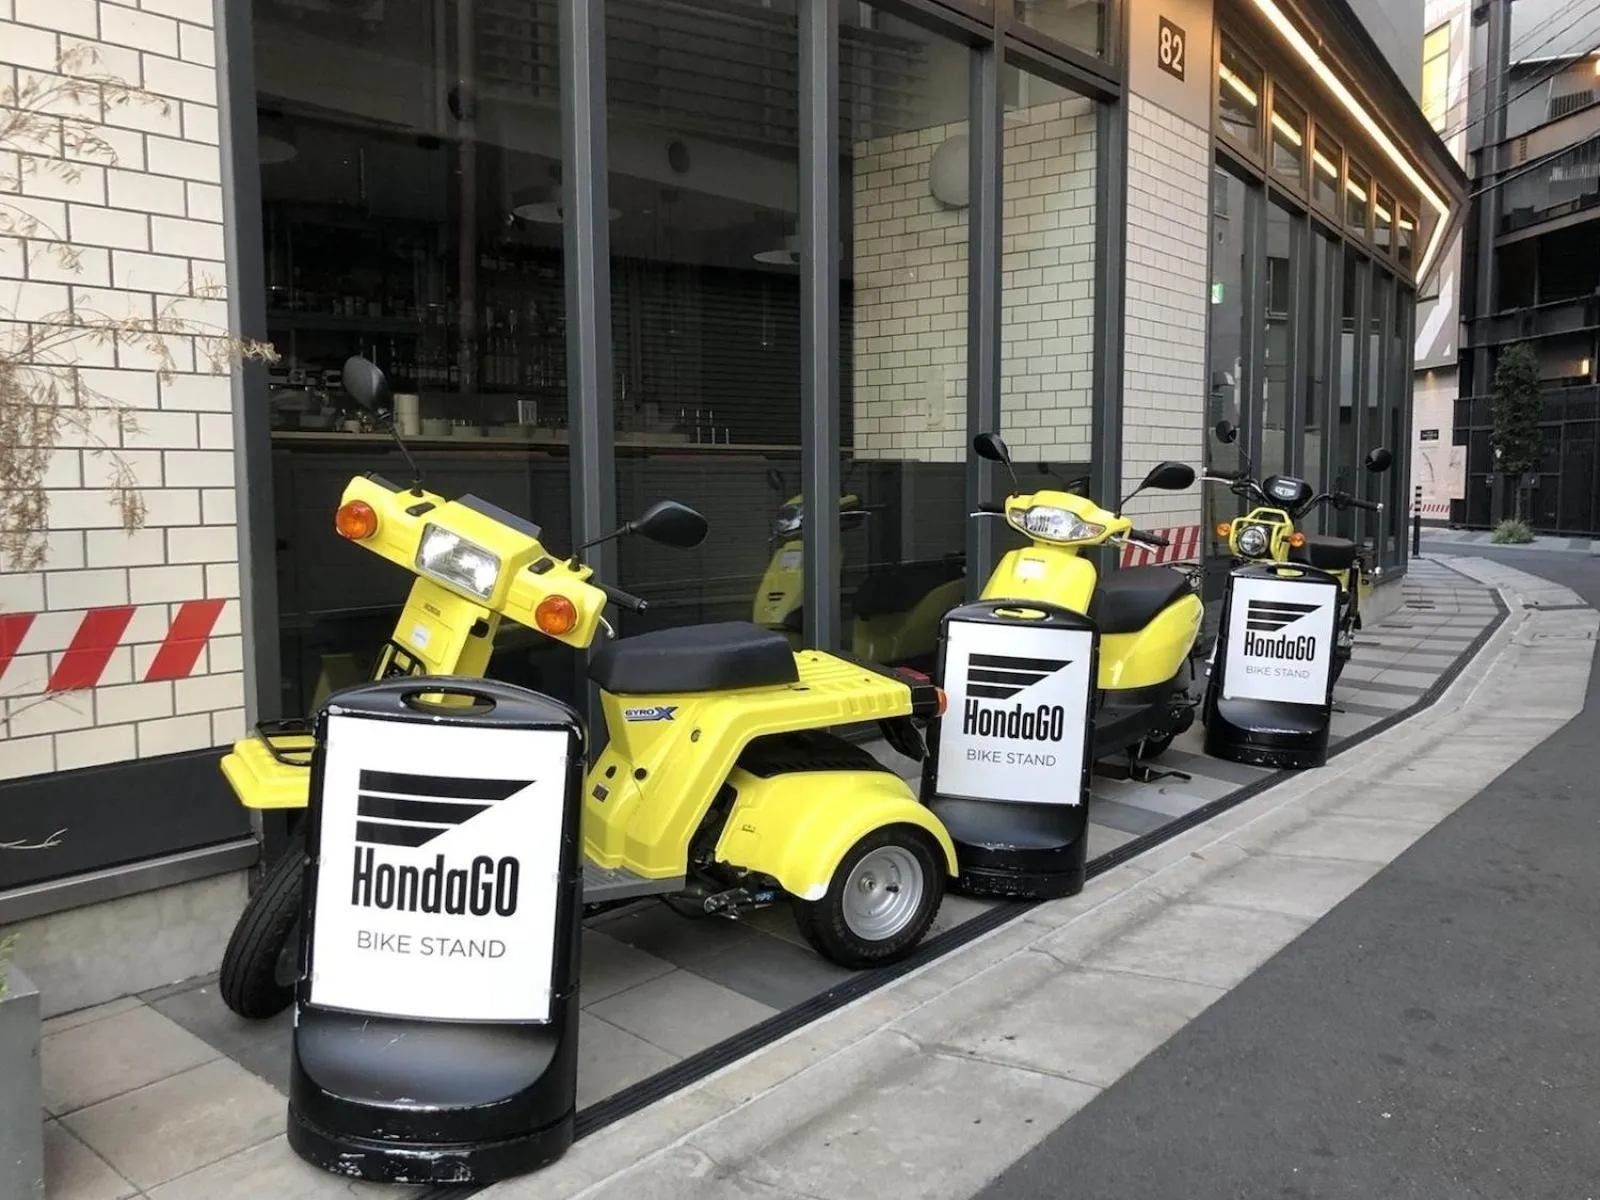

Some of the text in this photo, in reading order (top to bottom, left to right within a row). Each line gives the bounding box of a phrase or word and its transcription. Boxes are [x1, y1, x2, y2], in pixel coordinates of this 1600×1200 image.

[1161, 27, 1183, 72] 82
[1243, 631, 1316, 661] HondaGO
[1246, 665, 1310, 679] BIKE STAND
[963, 698, 1064, 742] HondaGO
[967, 748, 1057, 767] BIKE STAND
[351, 845, 520, 917] HondaGO
[356, 930, 506, 959] BIKE STAND
